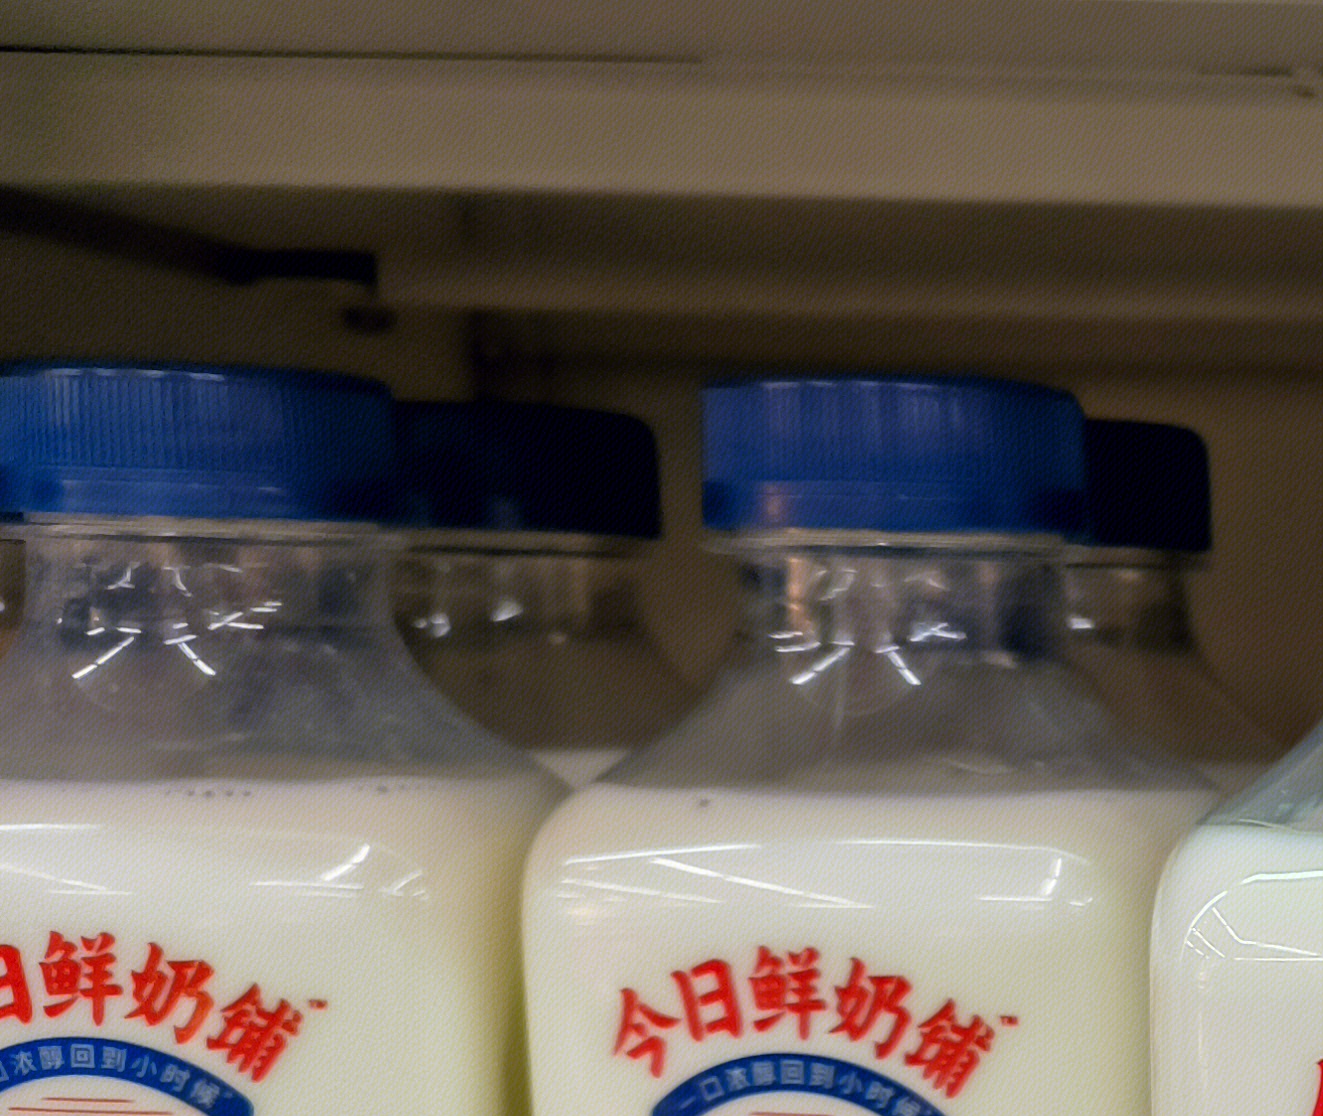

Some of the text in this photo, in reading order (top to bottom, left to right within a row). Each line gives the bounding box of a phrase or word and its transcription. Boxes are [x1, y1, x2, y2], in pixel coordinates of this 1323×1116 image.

[612, 946, 995, 1098] 今日鲜奶铺
